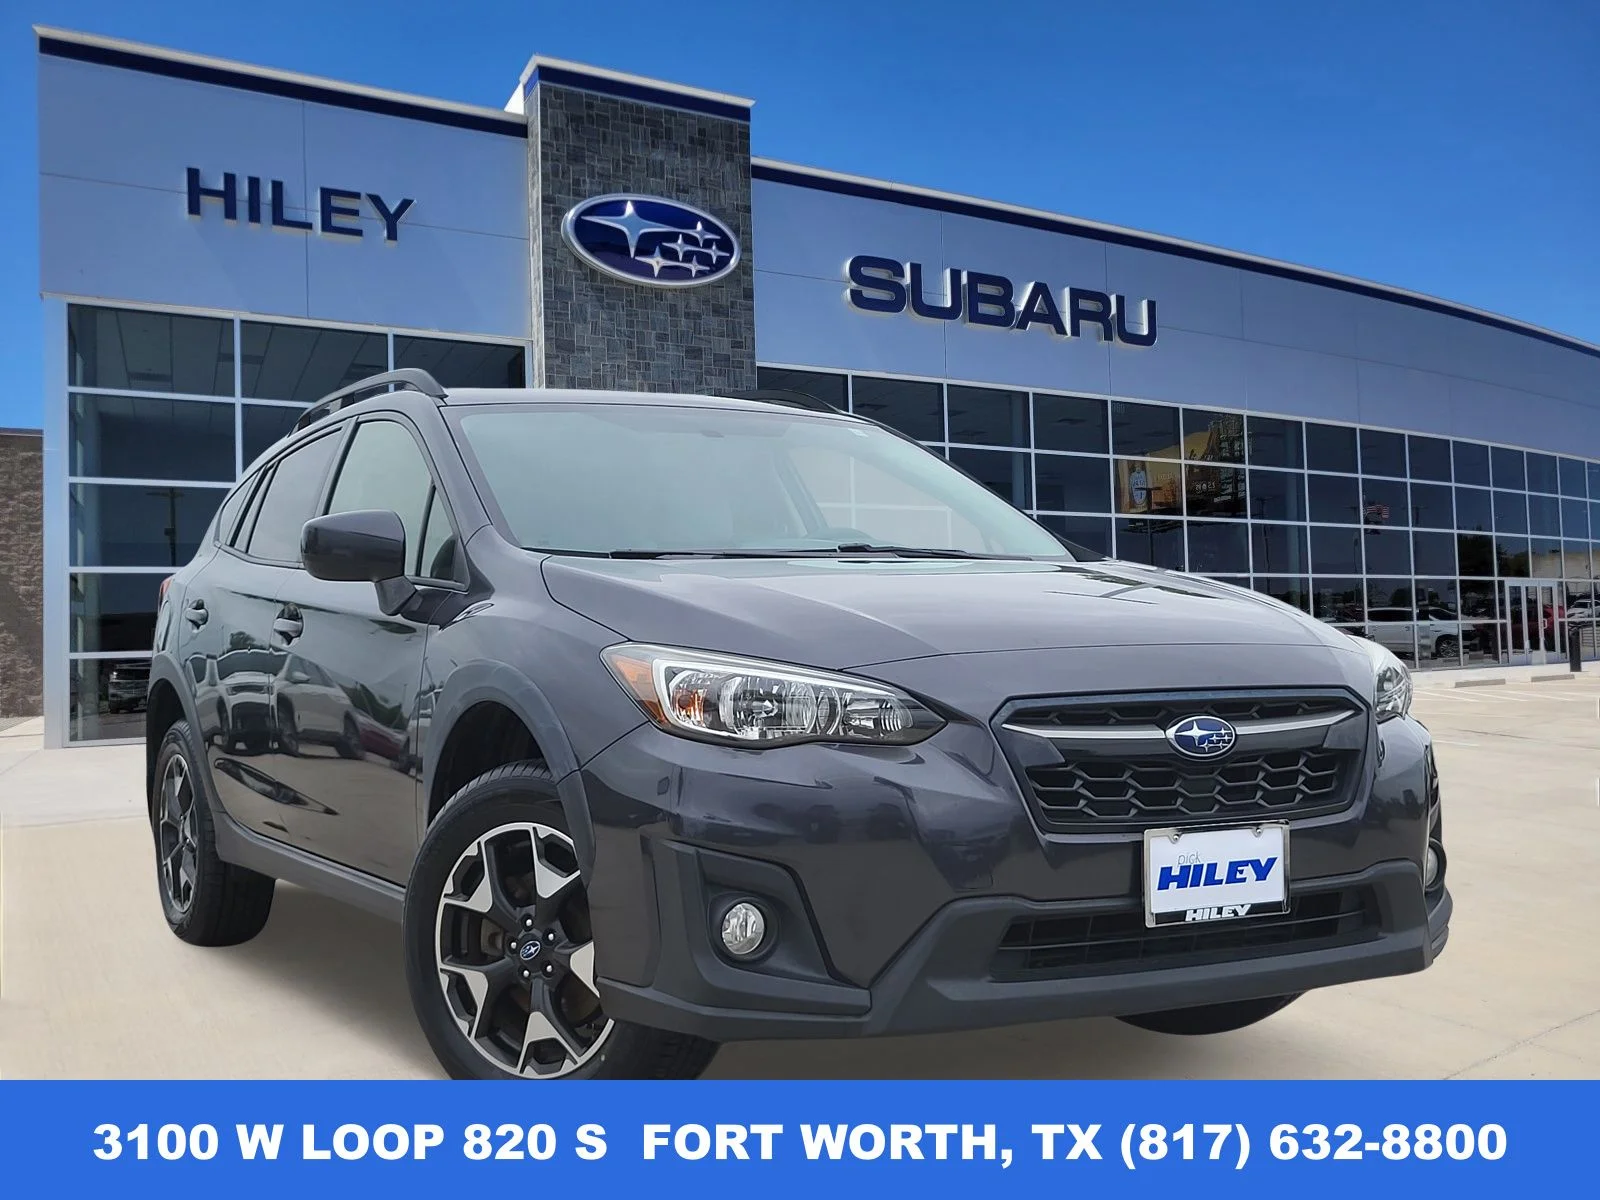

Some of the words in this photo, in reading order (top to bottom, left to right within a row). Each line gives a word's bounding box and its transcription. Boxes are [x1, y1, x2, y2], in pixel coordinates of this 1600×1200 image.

[186, 166, 415, 242] HILEY
[848, 255, 1158, 347] SUBARU
[1157, 857, 1278, 891] HILEY
[1185, 903, 1252, 922] HILEY
